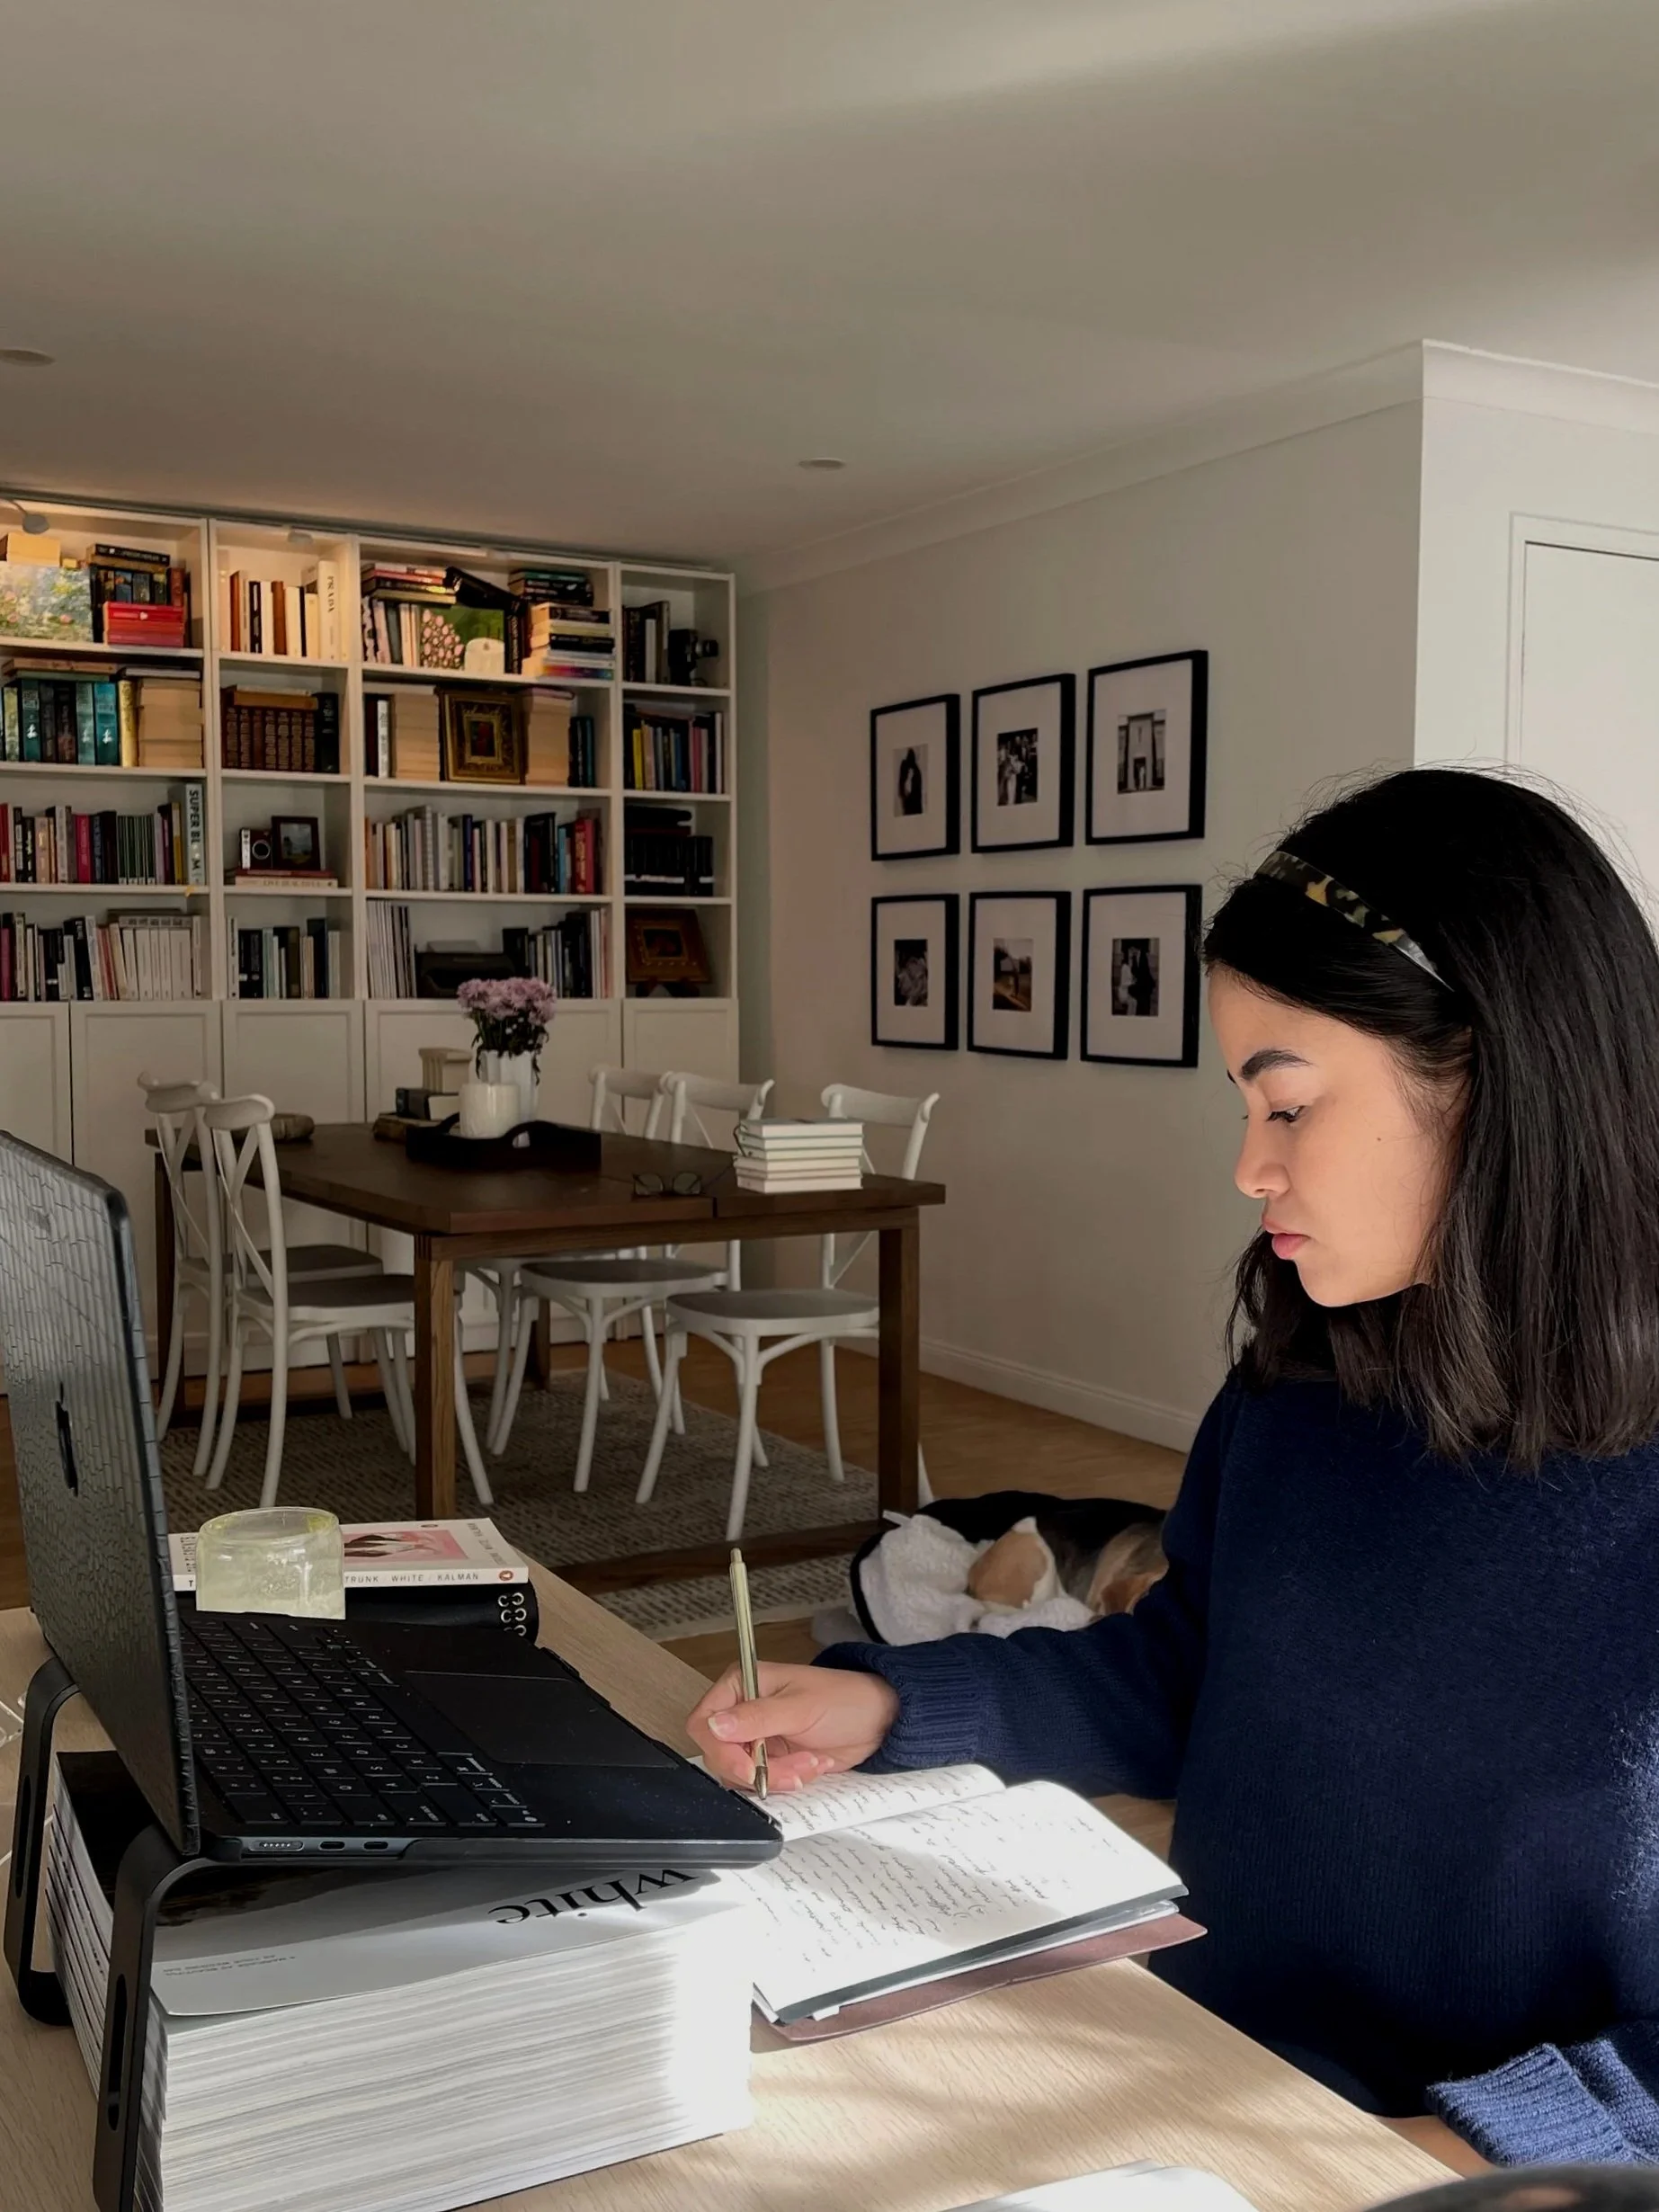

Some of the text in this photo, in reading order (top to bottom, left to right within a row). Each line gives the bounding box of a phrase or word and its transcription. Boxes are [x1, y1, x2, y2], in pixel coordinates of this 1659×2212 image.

[189, 789, 201, 870] SUPER BLM
[344, 1573, 479, 1583] TRUNK WHITE KALMAN
[487, 1869, 700, 1924] white
